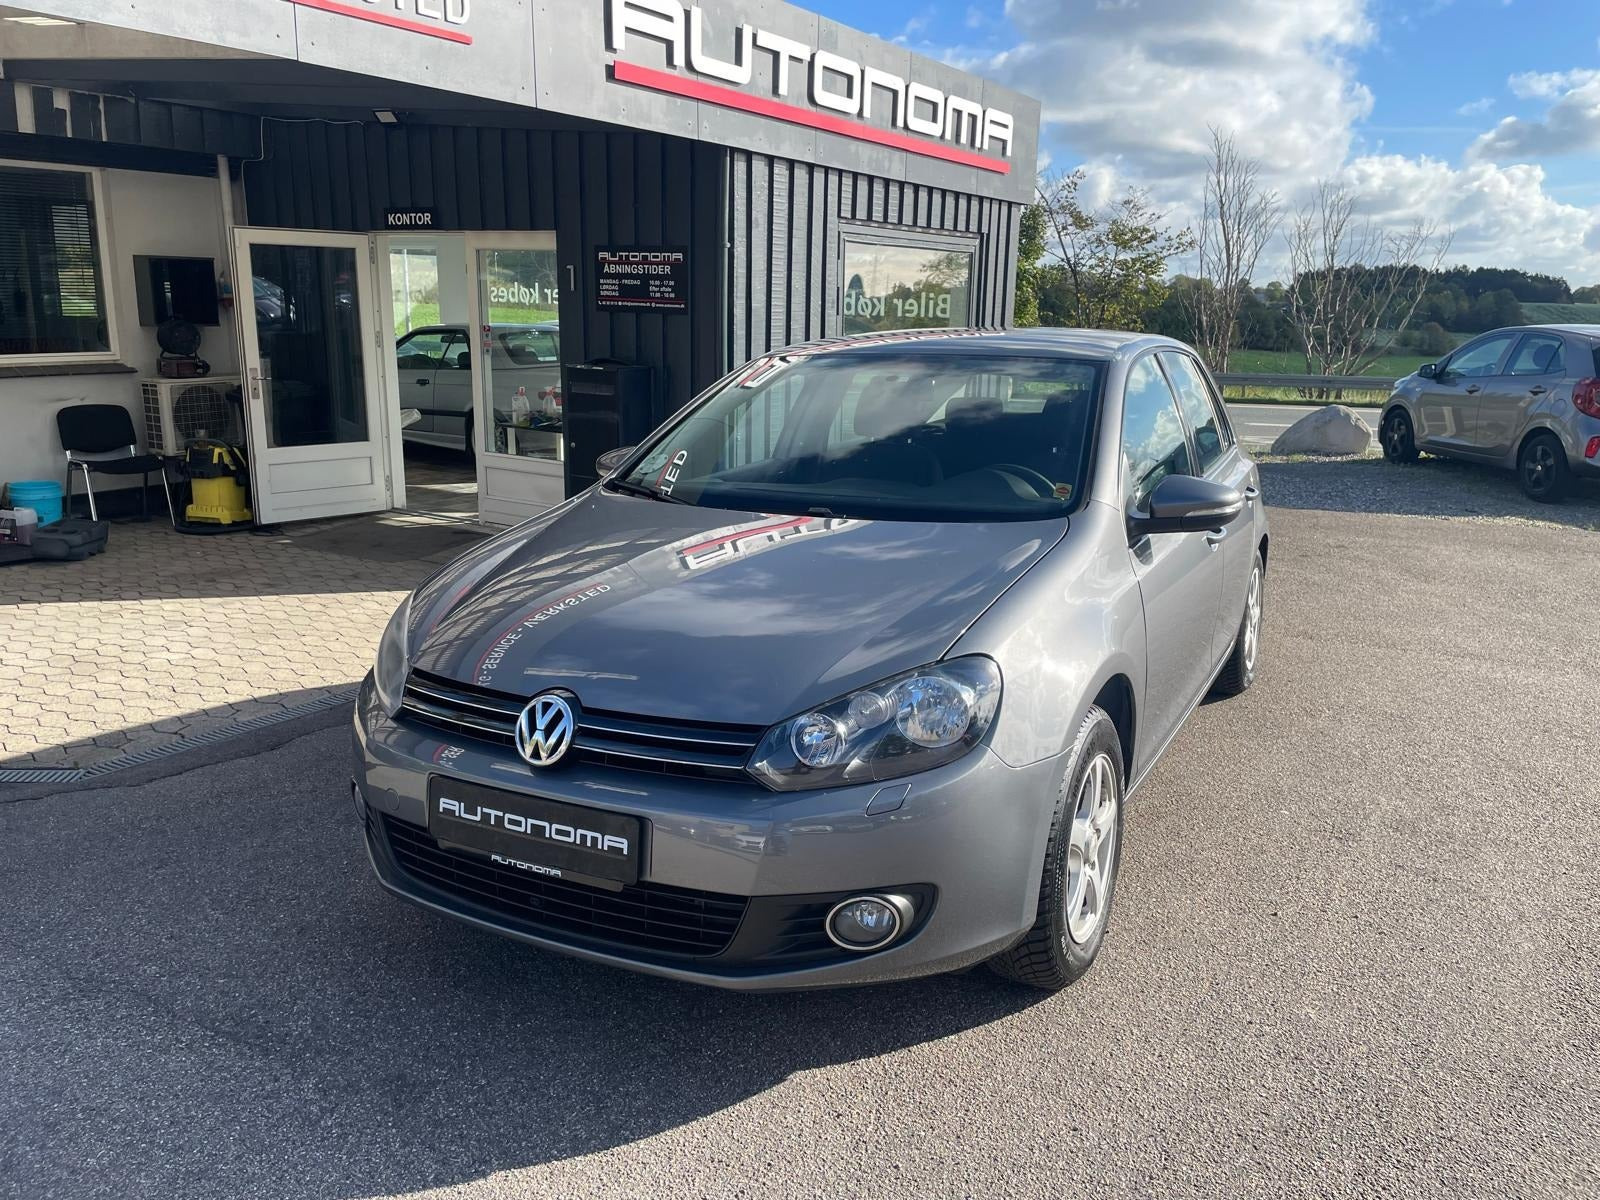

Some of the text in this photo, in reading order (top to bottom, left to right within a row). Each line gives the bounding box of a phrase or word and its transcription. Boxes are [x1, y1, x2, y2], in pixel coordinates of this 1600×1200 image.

[610, 0, 1014, 157] AUTONOMA
[388, 213, 432, 225] KONTOR
[598, 252, 683, 262] AUTONOMA
[603, 263, 671, 275] ÅBNINGSTIDER
[439, 797, 628, 855] AUTONOMA
[491, 854, 562, 878] AUTONOMA
